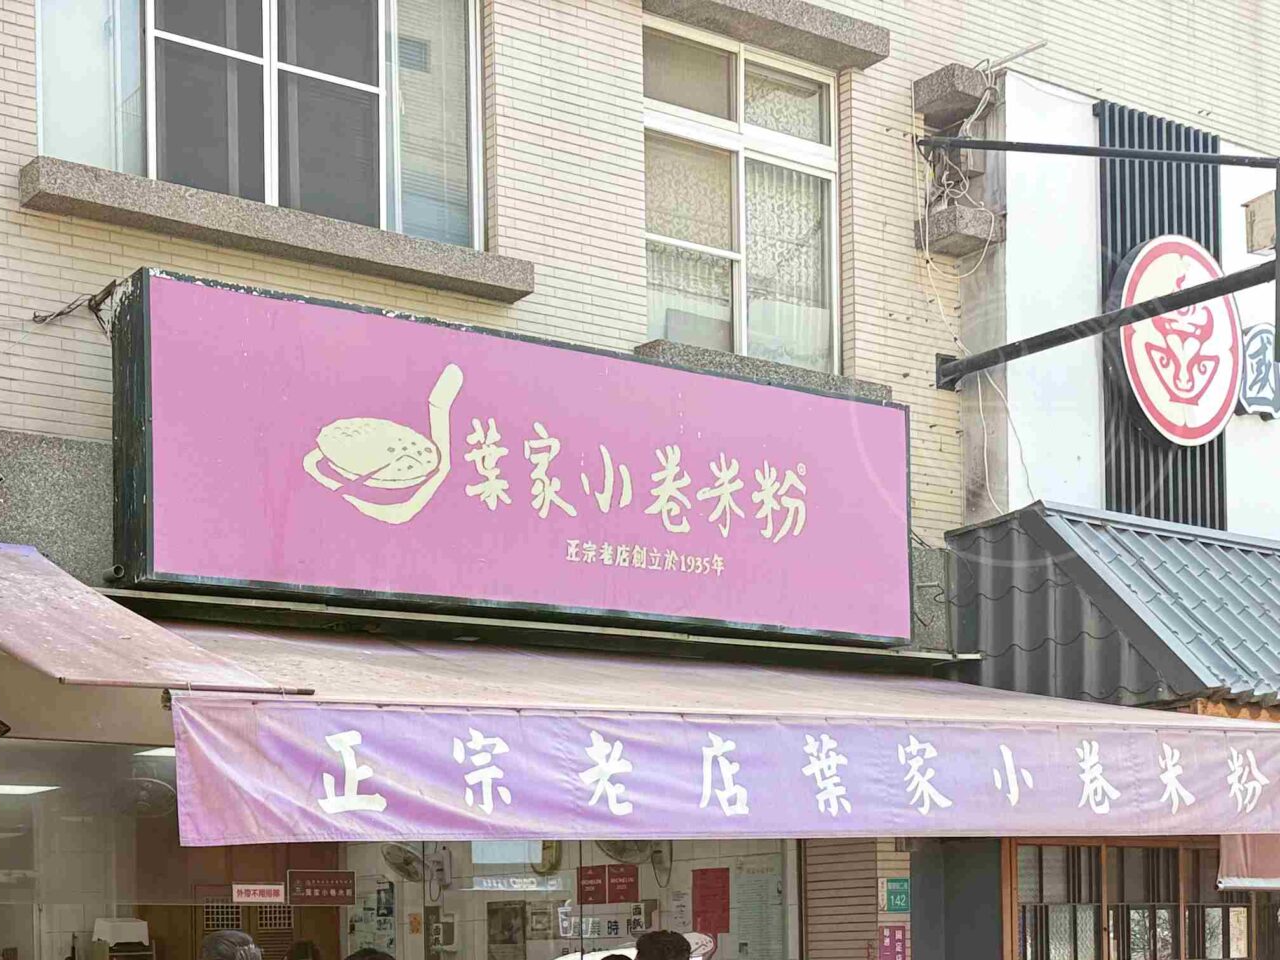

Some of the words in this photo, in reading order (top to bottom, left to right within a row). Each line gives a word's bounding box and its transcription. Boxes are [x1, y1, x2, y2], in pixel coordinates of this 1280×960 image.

[464, 418, 807, 543] 葉家小卷米粉
[566, 539, 725, 577] 正宗老店創立於1935年
[890, 894, 907, 906] 142
